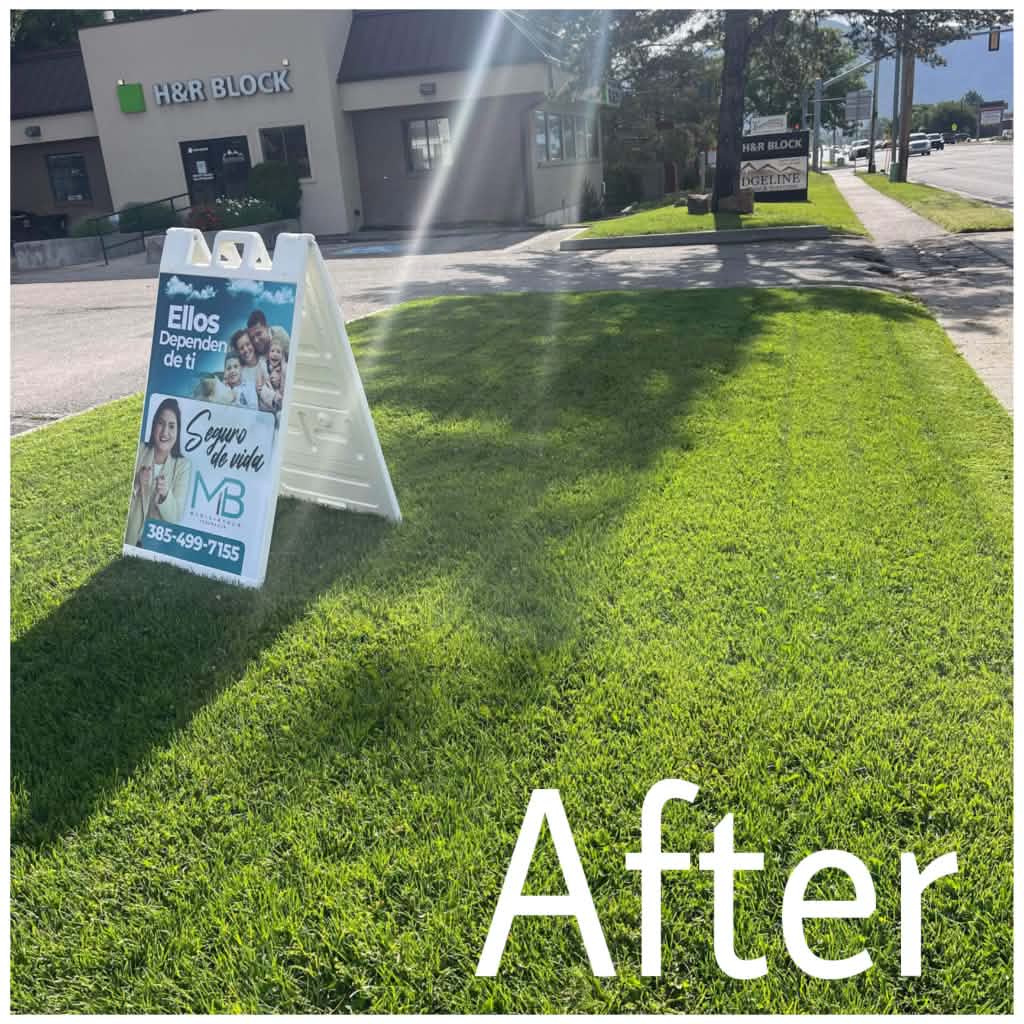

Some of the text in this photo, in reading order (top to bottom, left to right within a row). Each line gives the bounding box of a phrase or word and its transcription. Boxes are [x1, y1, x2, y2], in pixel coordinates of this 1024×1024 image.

[153, 70, 292, 106] H&R BLOCK
[742, 139, 802, 153] H&R BLOCK
[741, 173, 801, 186] DGELINE
[167, 305, 221, 334] Ellos
[159, 330, 228, 353] Dependen
[163, 351, 197, 370] de ti
[184, 408, 248, 456] Seguro
[210, 444, 265, 472] de vida
[190, 471, 246, 519] MB
[146, 523, 241, 562] 385-499-7155
